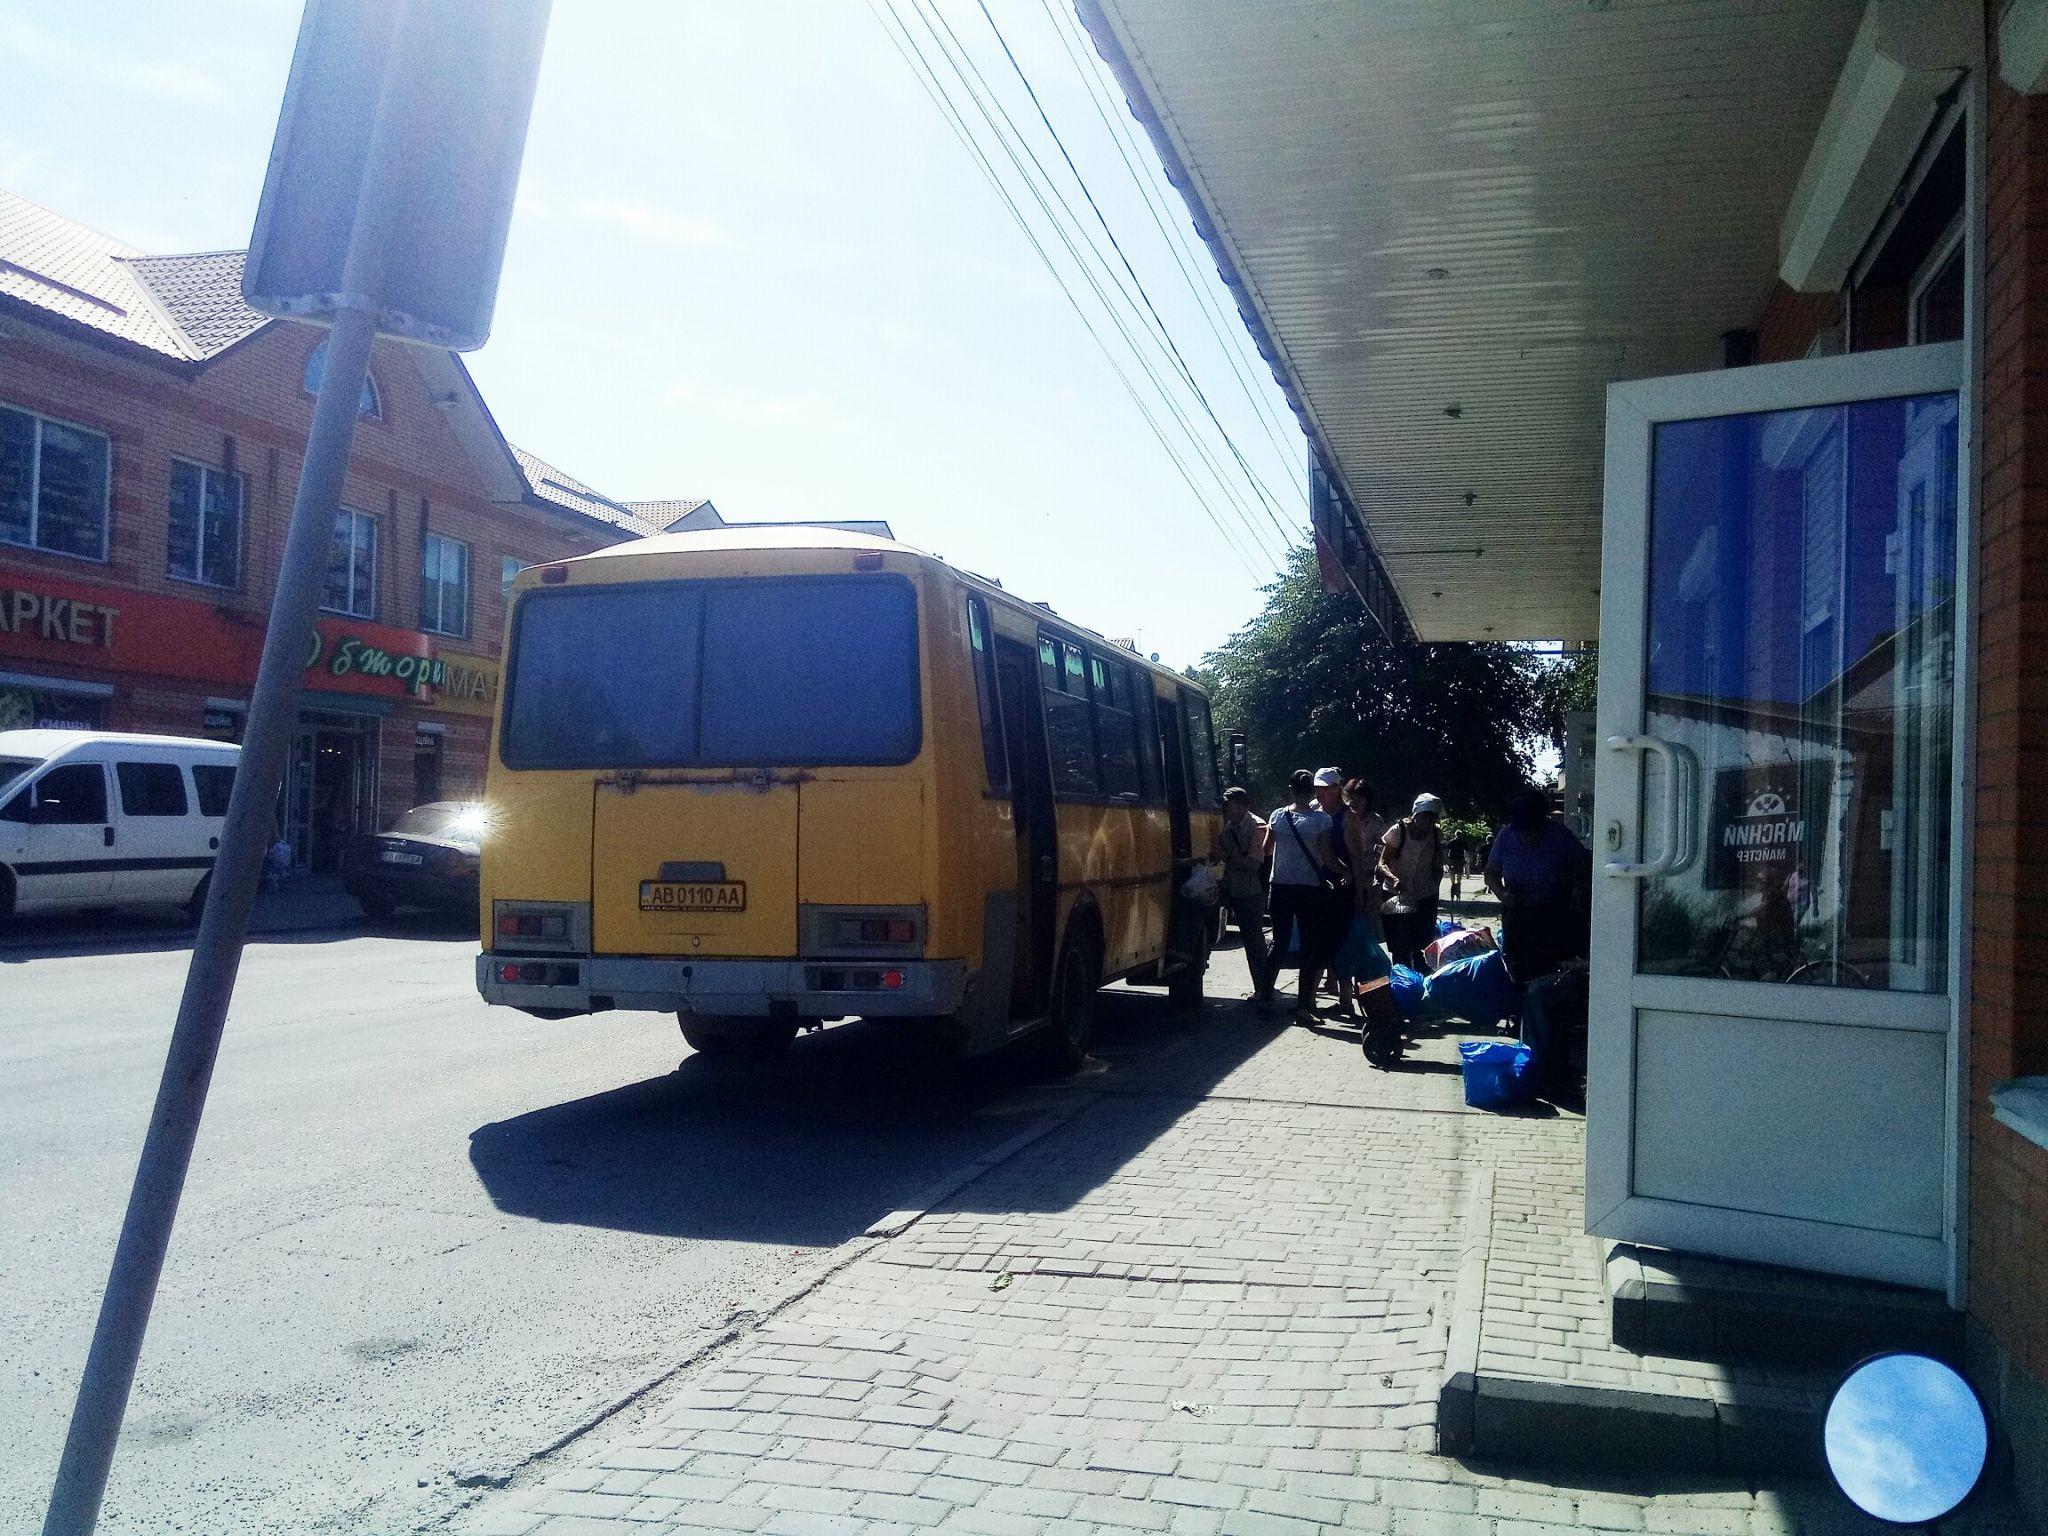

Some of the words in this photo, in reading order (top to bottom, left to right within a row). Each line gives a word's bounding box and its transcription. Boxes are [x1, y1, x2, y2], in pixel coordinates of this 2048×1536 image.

[447, 666, 500, 701] МА
[652, 887, 674, 904] AB
[677, 887, 714, 904] 0110
[717, 887, 739, 905] AA
